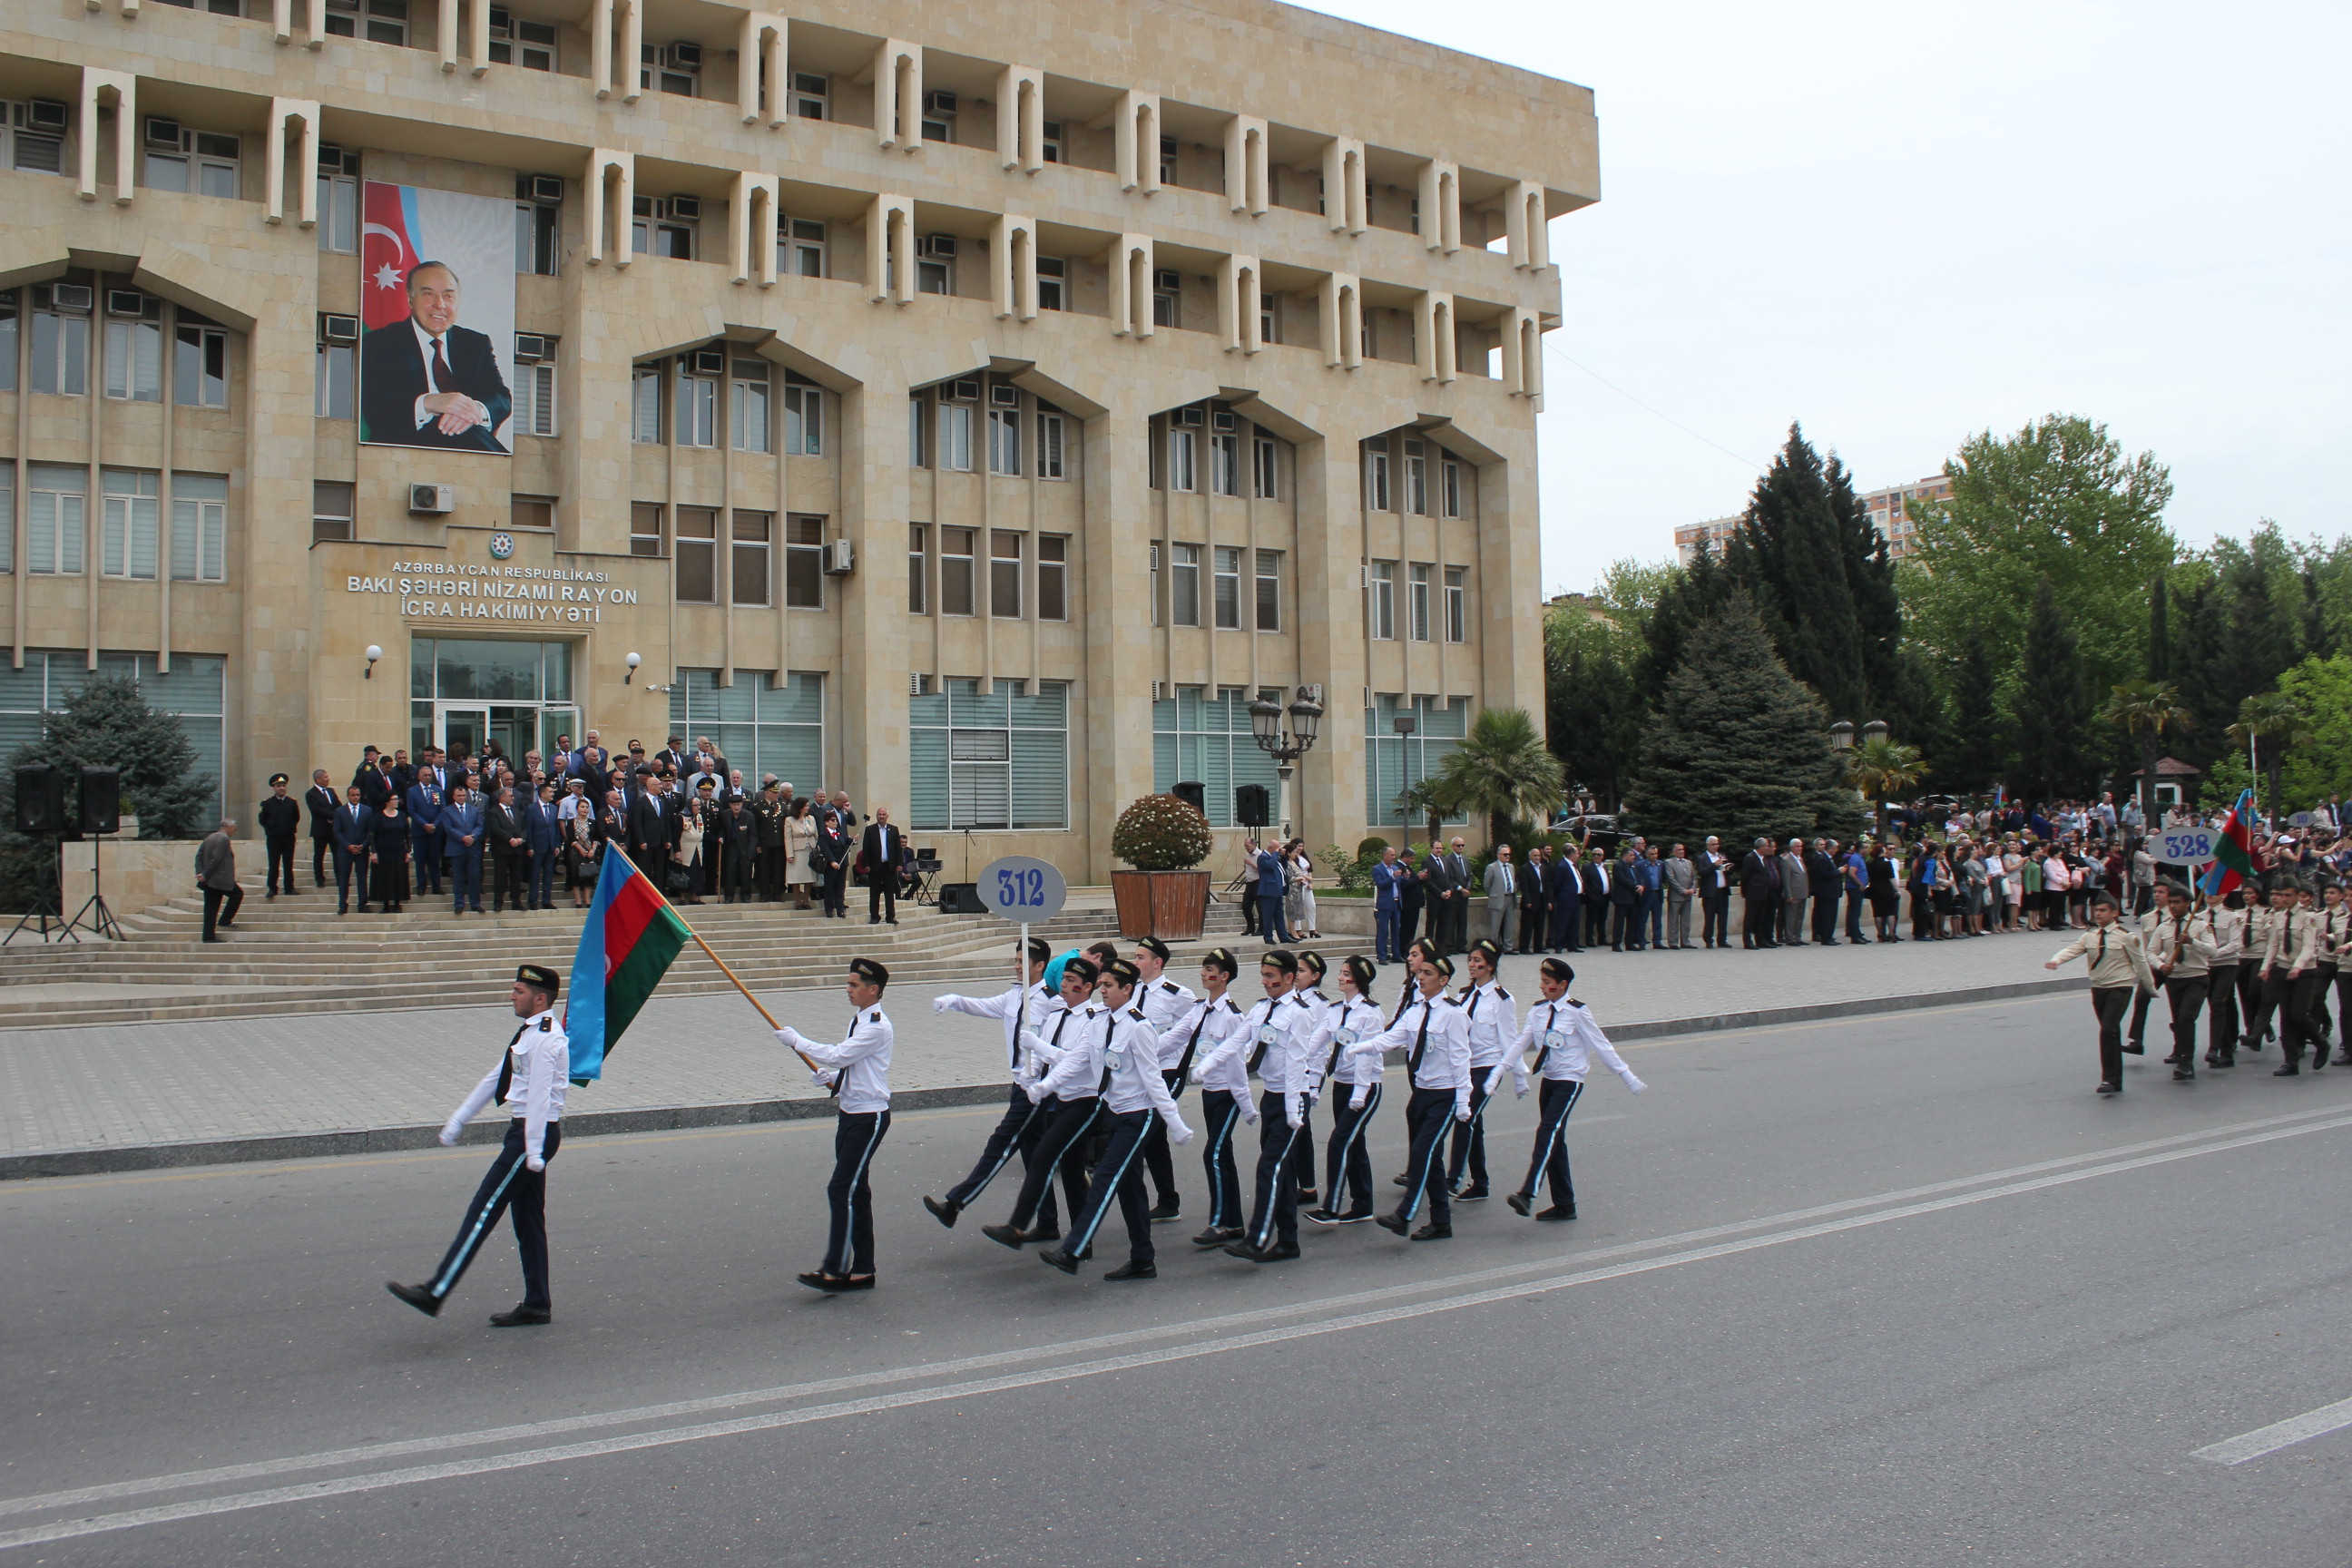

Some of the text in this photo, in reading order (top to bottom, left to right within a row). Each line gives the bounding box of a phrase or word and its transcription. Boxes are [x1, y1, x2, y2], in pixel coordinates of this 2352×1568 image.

[392, 562, 609, 583] AZƏRBAYCAN RESPUBLİKASI
[348, 576, 637, 604] BAKI ŞƏHƏRİ NİZAMİ RAYON
[401, 596, 600, 622] İCRA HAKİMİYYƏTİ
[2297, 814, 2308, 824] 10
[2165, 834, 2210, 858] 328
[997, 868, 1044, 906] 312
